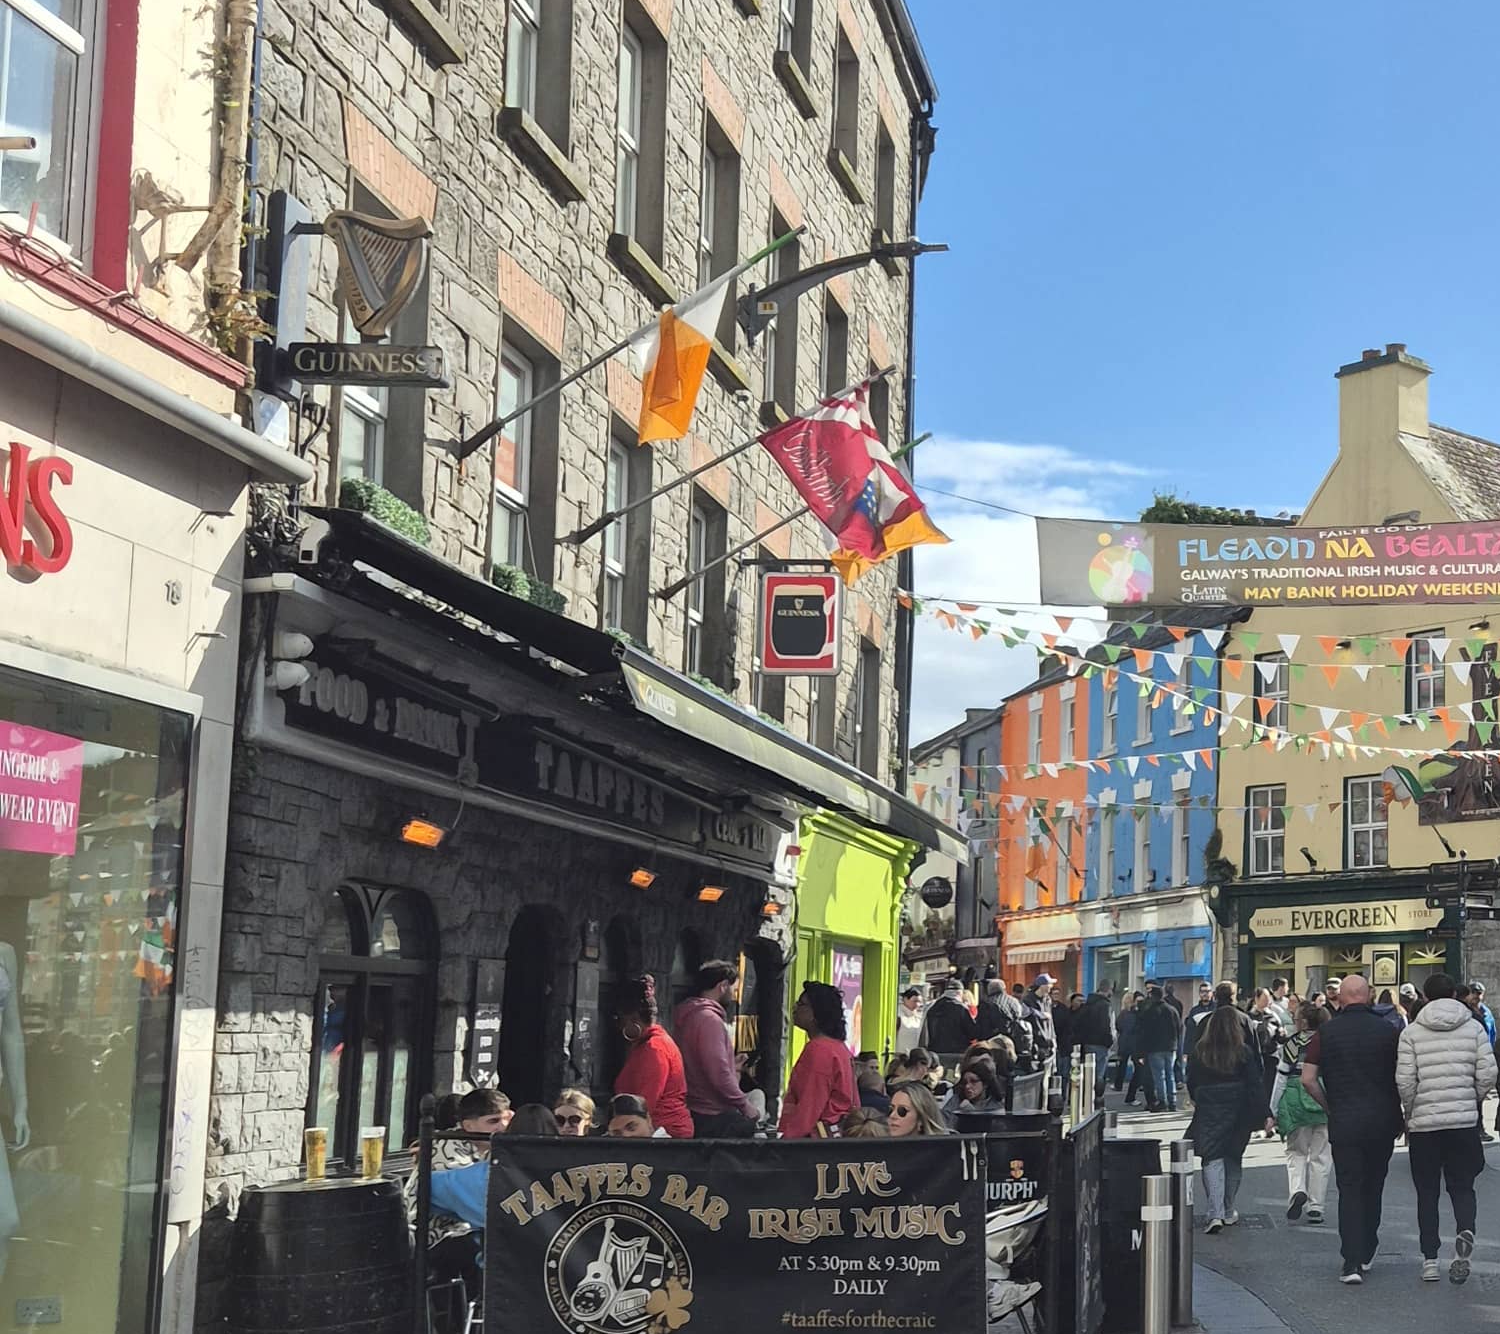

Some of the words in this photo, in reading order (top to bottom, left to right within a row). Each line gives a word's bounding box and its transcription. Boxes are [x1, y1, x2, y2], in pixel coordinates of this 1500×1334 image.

[294, 347, 428, 374] GUINNESS
[1325, 537, 1376, 559] NA
[1180, 568, 1249, 581] GALWAY'S
[1251, 566, 1344, 580] TRADITIONAL
[1347, 565, 1381, 578] IRISH
[1385, 564, 1426, 576] MUSIC
[1429, 564, 1439, 576] &
[1192, 584, 1227, 596] LATIN
[1244, 586, 1282, 600] MAY
[1286, 586, 1337, 599] BANK
[1341, 583, 1419, 598] HOLIDAY
[534, 739, 665, 825] TAAFFES
[37, 798, 77, 828] EVENT
[1256, 918, 1284, 928] HEALTH
[1290, 904, 1399, 931] EVERGREEN
[1407, 909, 1433, 919] STORE
[813, 1161, 901, 1201] LIVE
[986, 1181, 1038, 1201] URPH
[501, 1163, 653, 1226] TAAFFES
[660, 1174, 729, 1231] BAR
[551, 1204, 614, 1255] TRADITIONAL
[617, 1204, 648, 1221] IRISH
[650, 1218, 676, 1246] MUSIC
[748, 1207, 845, 1245] IRISH
[850, 1202, 967, 1246] MUSIC
[778, 1256, 802, 1271] AT
[806, 1255, 864, 1275] 5.30pm
[867, 1256, 882, 1272] &
[885, 1255, 941, 1276] 9.30pm
[833, 1278, 889, 1296] DAILY
[781, 1309, 937, 1329] #taaffesforthecraic
